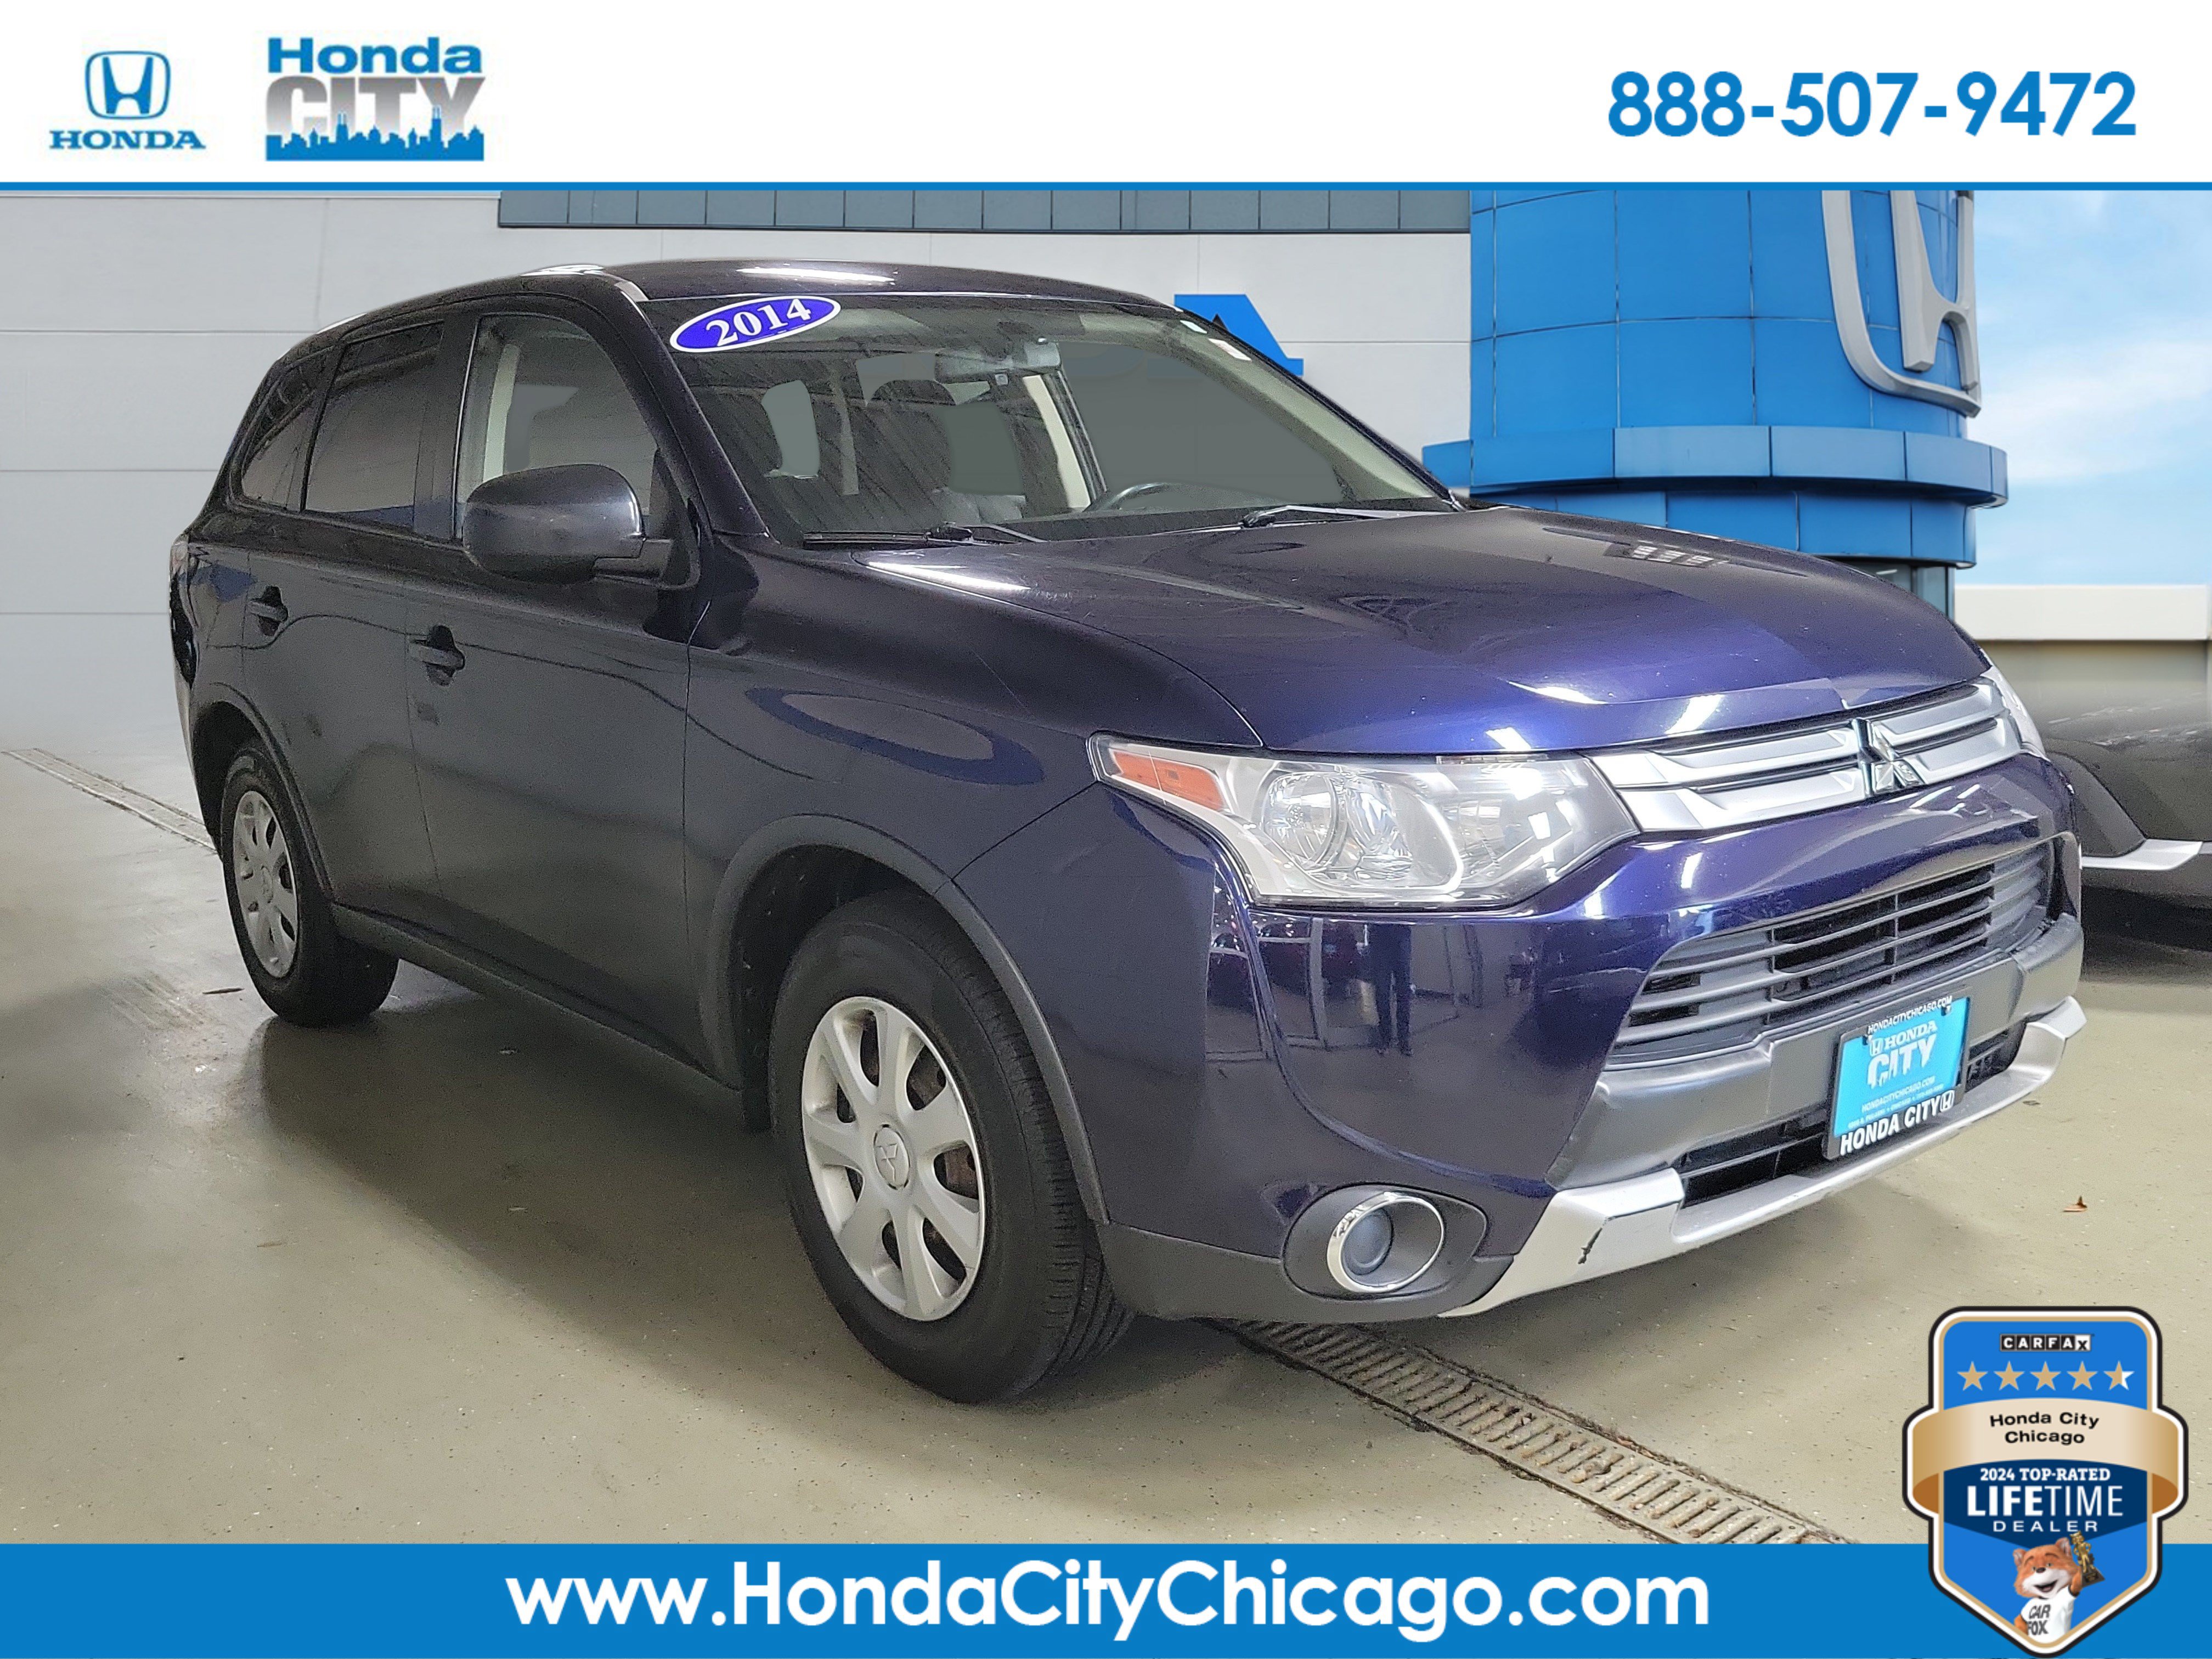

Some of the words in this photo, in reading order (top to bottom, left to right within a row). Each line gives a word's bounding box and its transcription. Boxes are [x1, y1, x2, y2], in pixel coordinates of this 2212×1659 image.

[706, 298, 811, 347] 2014
[1867, 1033, 1937, 1090] CITY
[1884, 1020, 1938, 1050] HONDA
[1840, 1113, 1901, 1156] HONDA
[1904, 1095, 1942, 1128] CITY
